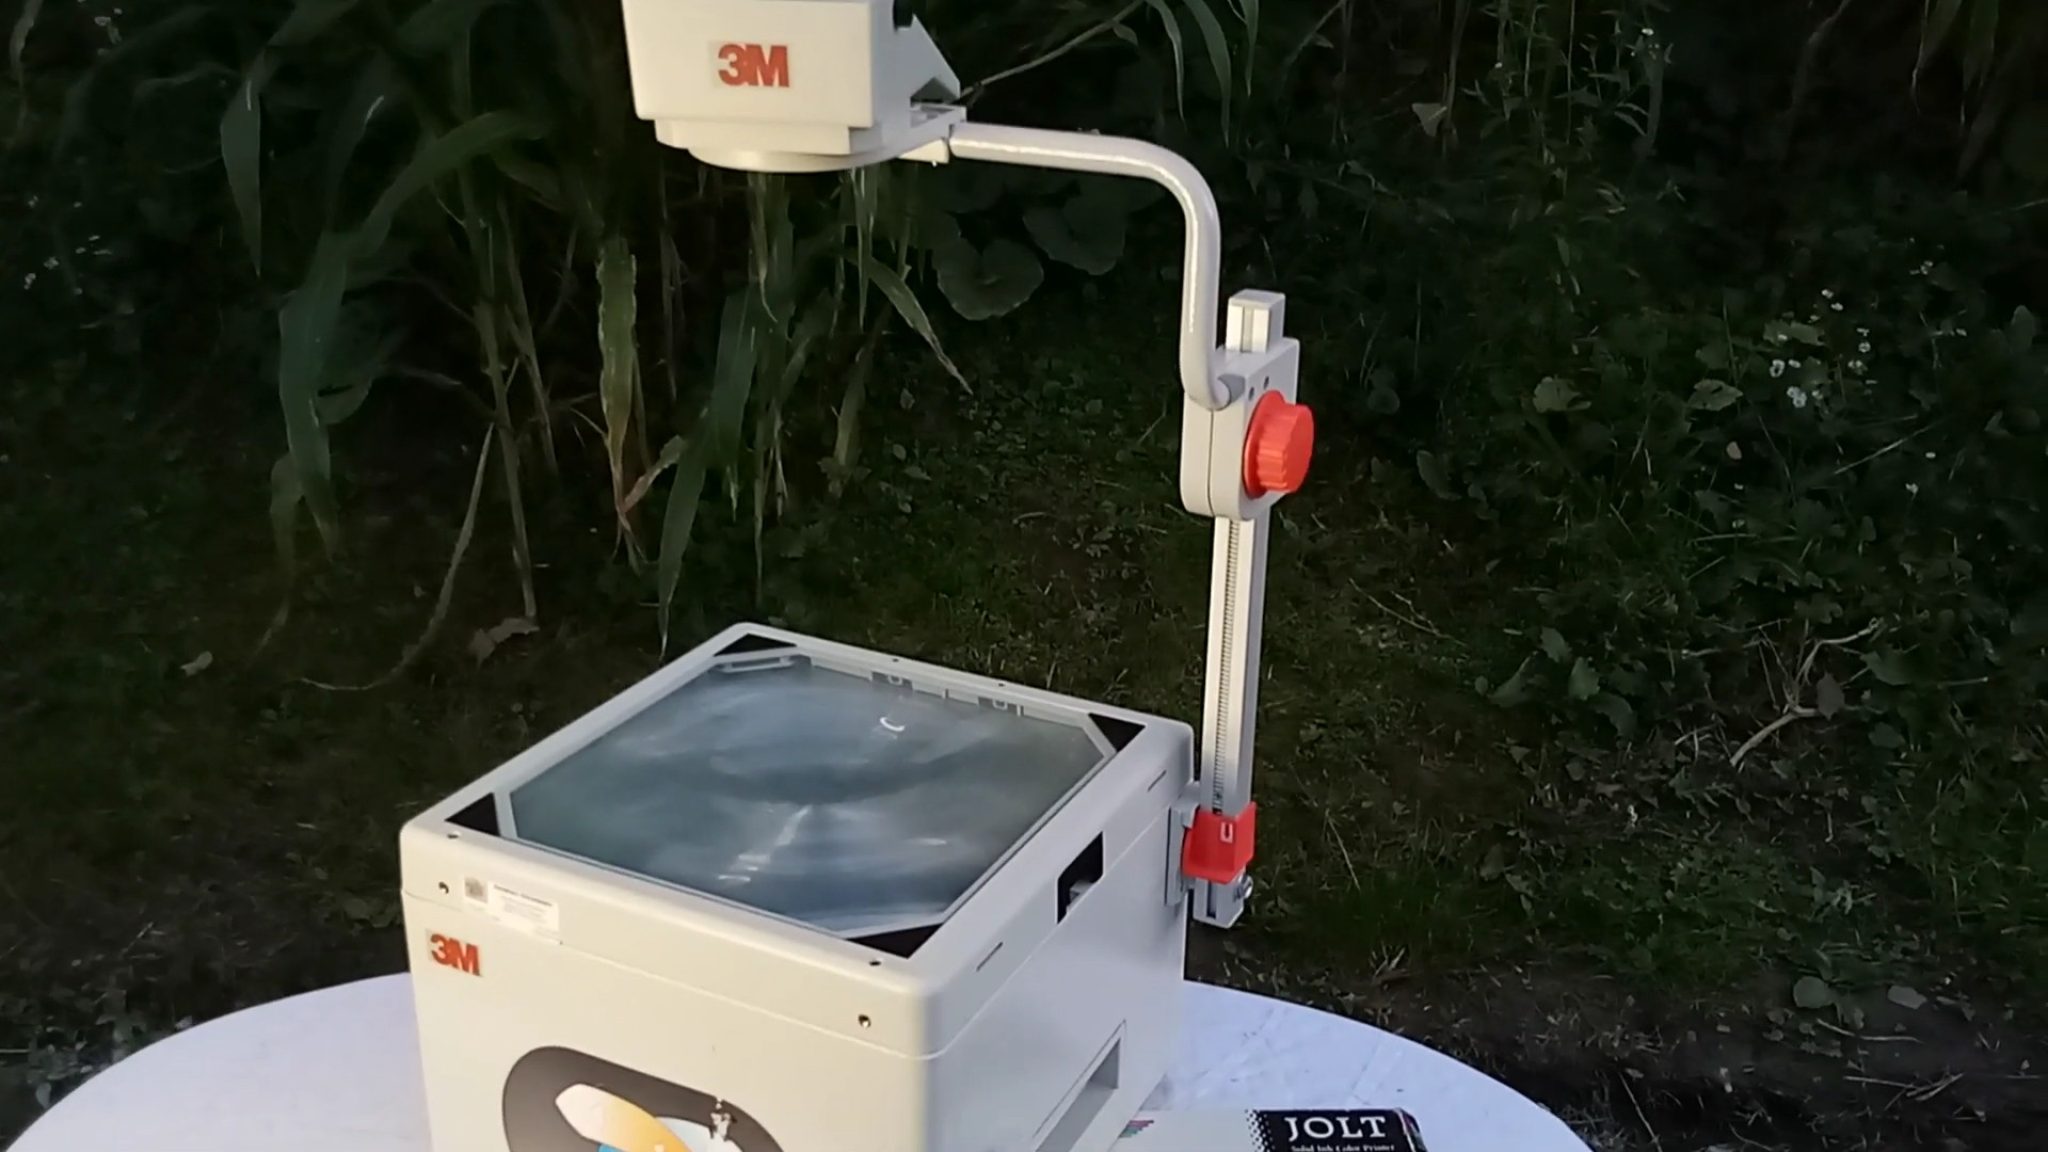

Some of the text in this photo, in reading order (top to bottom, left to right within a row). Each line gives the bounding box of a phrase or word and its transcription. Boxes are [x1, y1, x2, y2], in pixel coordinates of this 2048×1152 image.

[718, 44, 790, 88] 3M
[430, 933, 481, 977] 3M
[1284, 1116, 1386, 1142] JOLT
